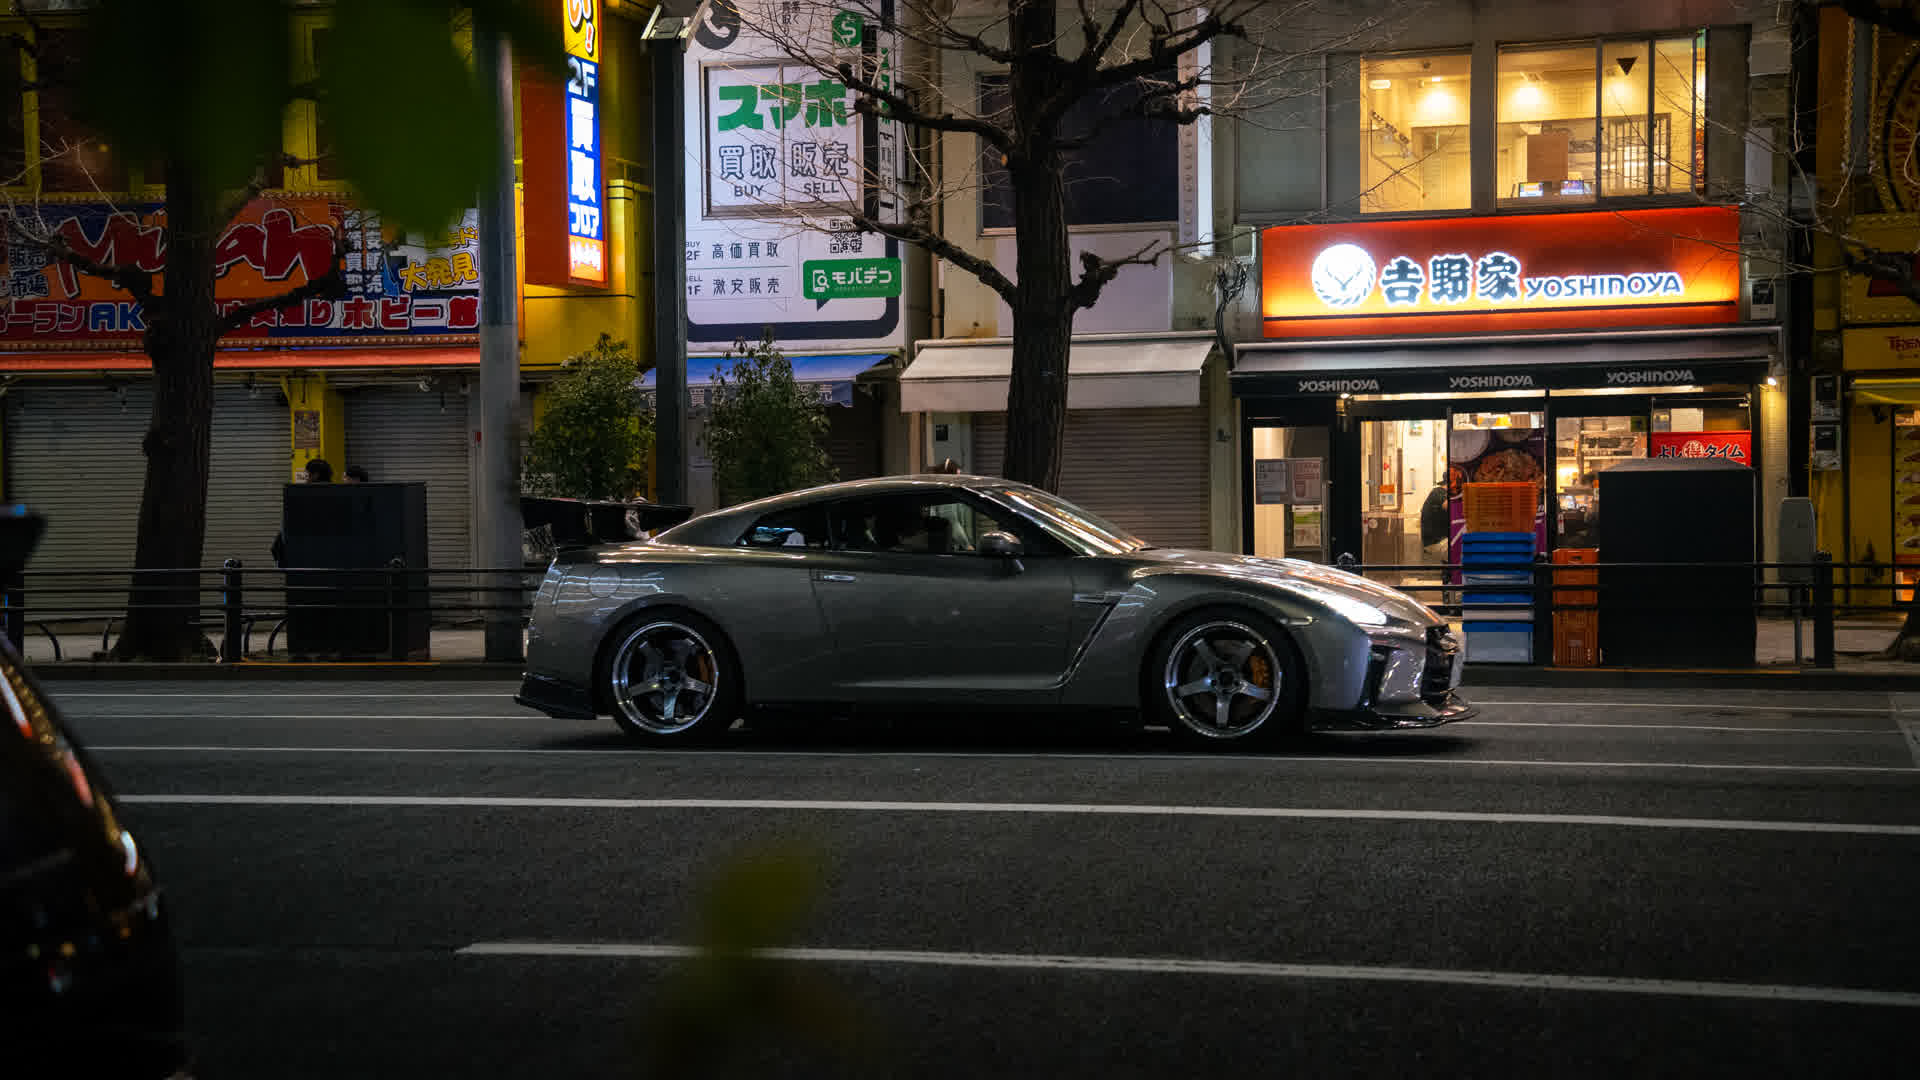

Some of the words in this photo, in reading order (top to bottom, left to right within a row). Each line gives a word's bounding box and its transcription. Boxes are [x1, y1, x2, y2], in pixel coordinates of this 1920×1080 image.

[718, 79, 848, 132] スマホ
[719, 144, 777, 180] 買取
[790, 141, 849, 178] 販売
[734, 185, 764, 198] BUY
[803, 182, 840, 194] SELL
[686, 250, 701, 261] 2F
[711, 241, 779, 260] 高価買取
[400, 251, 479, 292] 大発見
[687, 275, 703, 283] ELL
[831, 266, 893, 286] モバデコ
[687, 285, 702, 296] 1F
[712, 277, 780, 296] 激安販売
[1526, 273, 1683, 299] YOSHINOYA
[1298, 378, 1380, 392] YOSHINOYA
[1449, 375, 1534, 389] YOSHINOYA
[1608, 369, 1695, 384] YOSHINOYA
